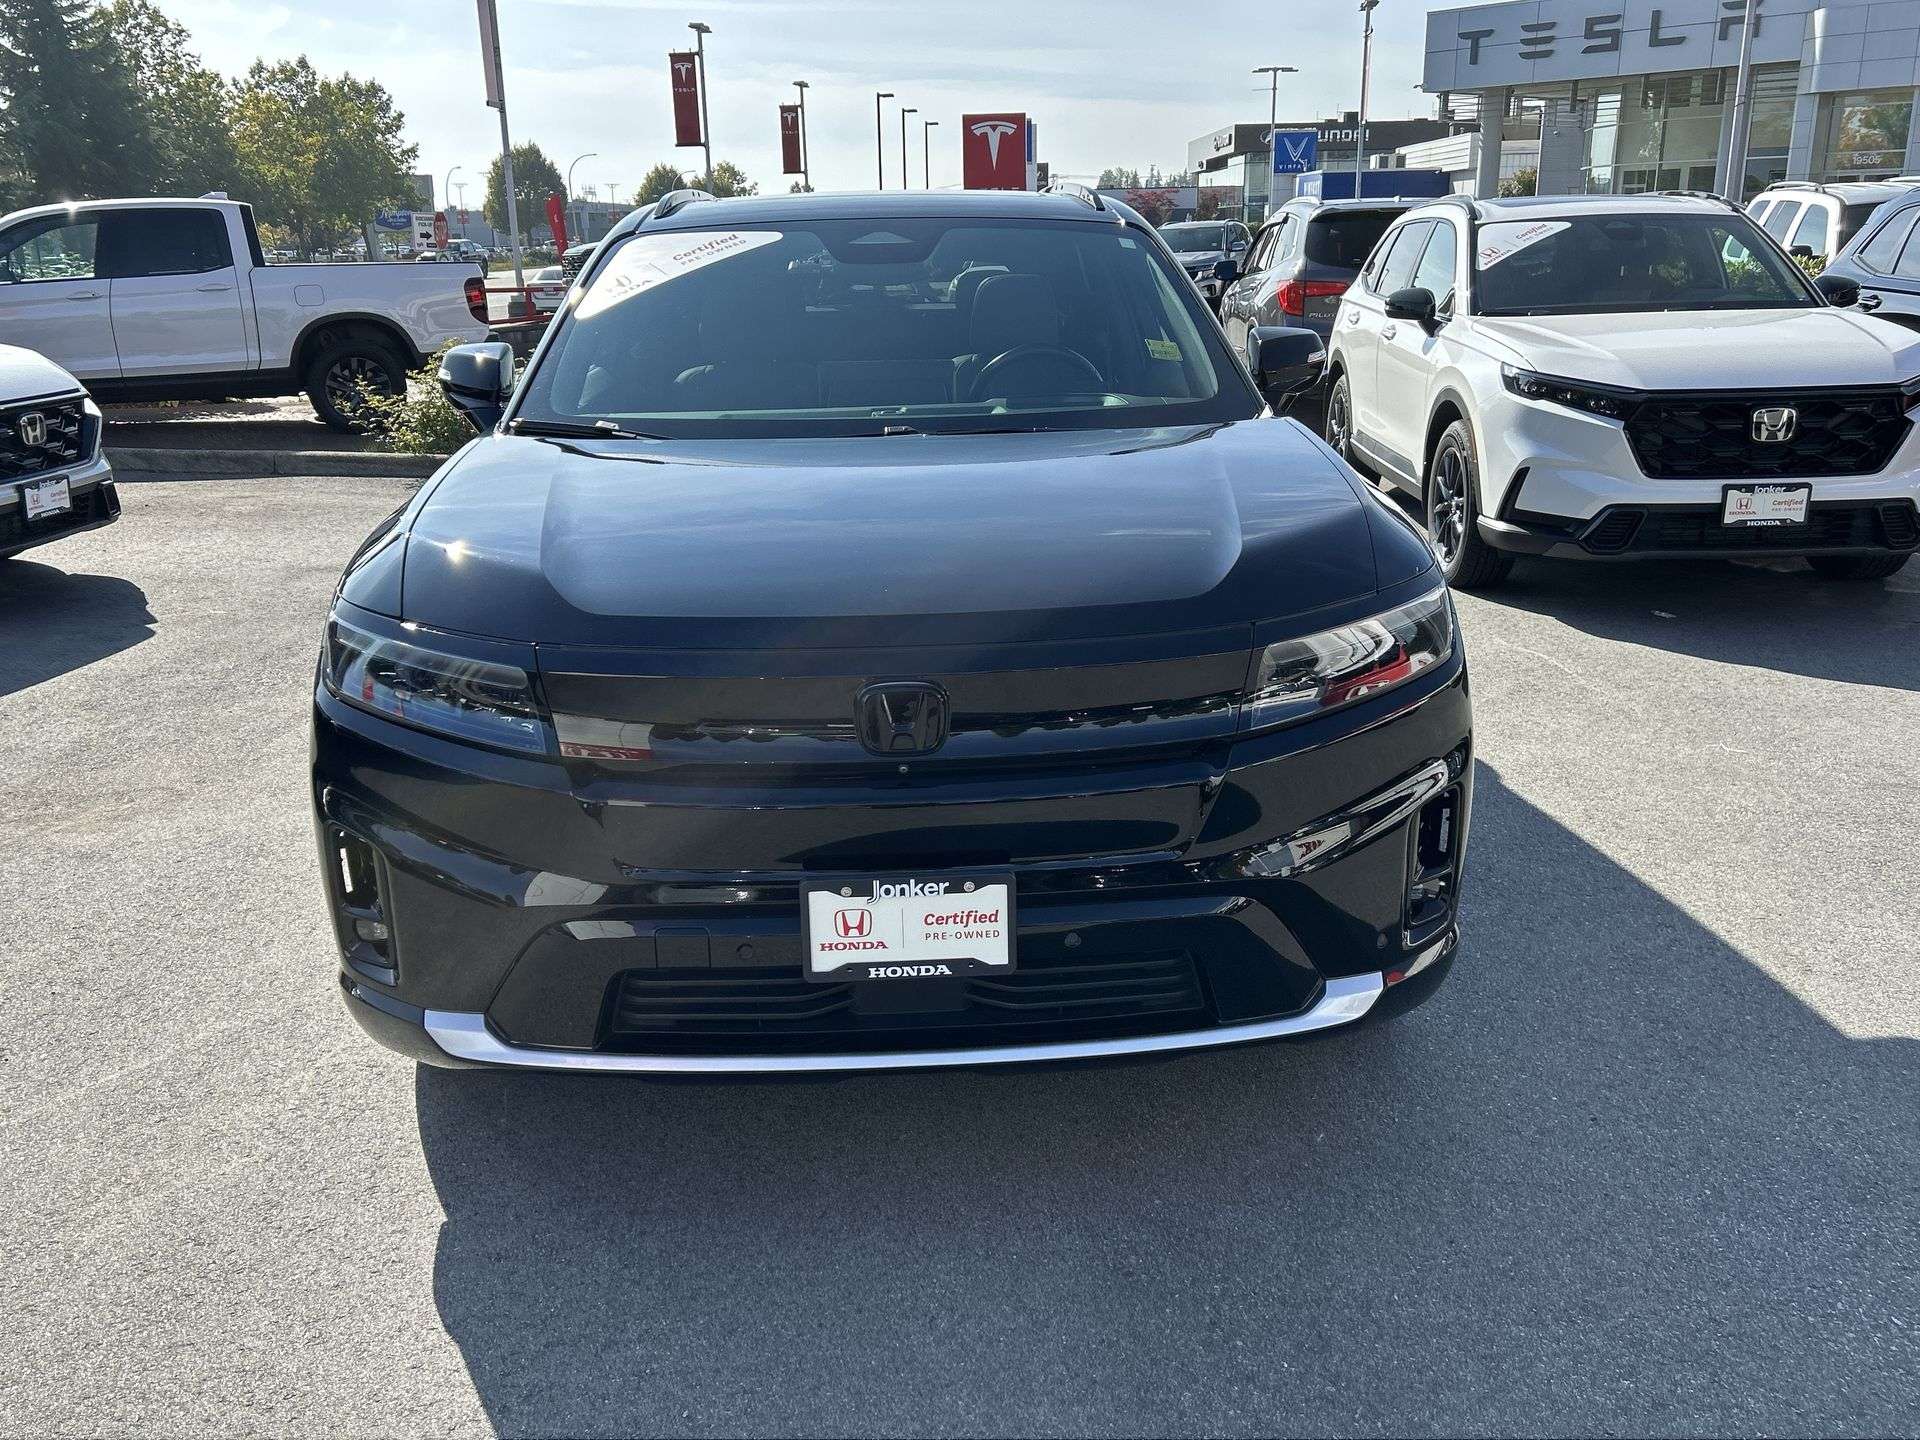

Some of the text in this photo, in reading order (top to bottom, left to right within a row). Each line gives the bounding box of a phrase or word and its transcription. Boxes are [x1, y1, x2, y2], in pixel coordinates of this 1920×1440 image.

[1458, 0, 1761, 65] TESLA
[673, 233, 739, 261] Certified
[1750, 485, 1786, 496] Jonker
[1772, 498, 1804, 507] Certified
[867, 879, 949, 904] Jonker
[924, 909, 999, 928] Certified
[924, 929, 1001, 941] PRE-OWNED
[820, 940, 888, 951] HONDA
[868, 964, 952, 979] HONDA
